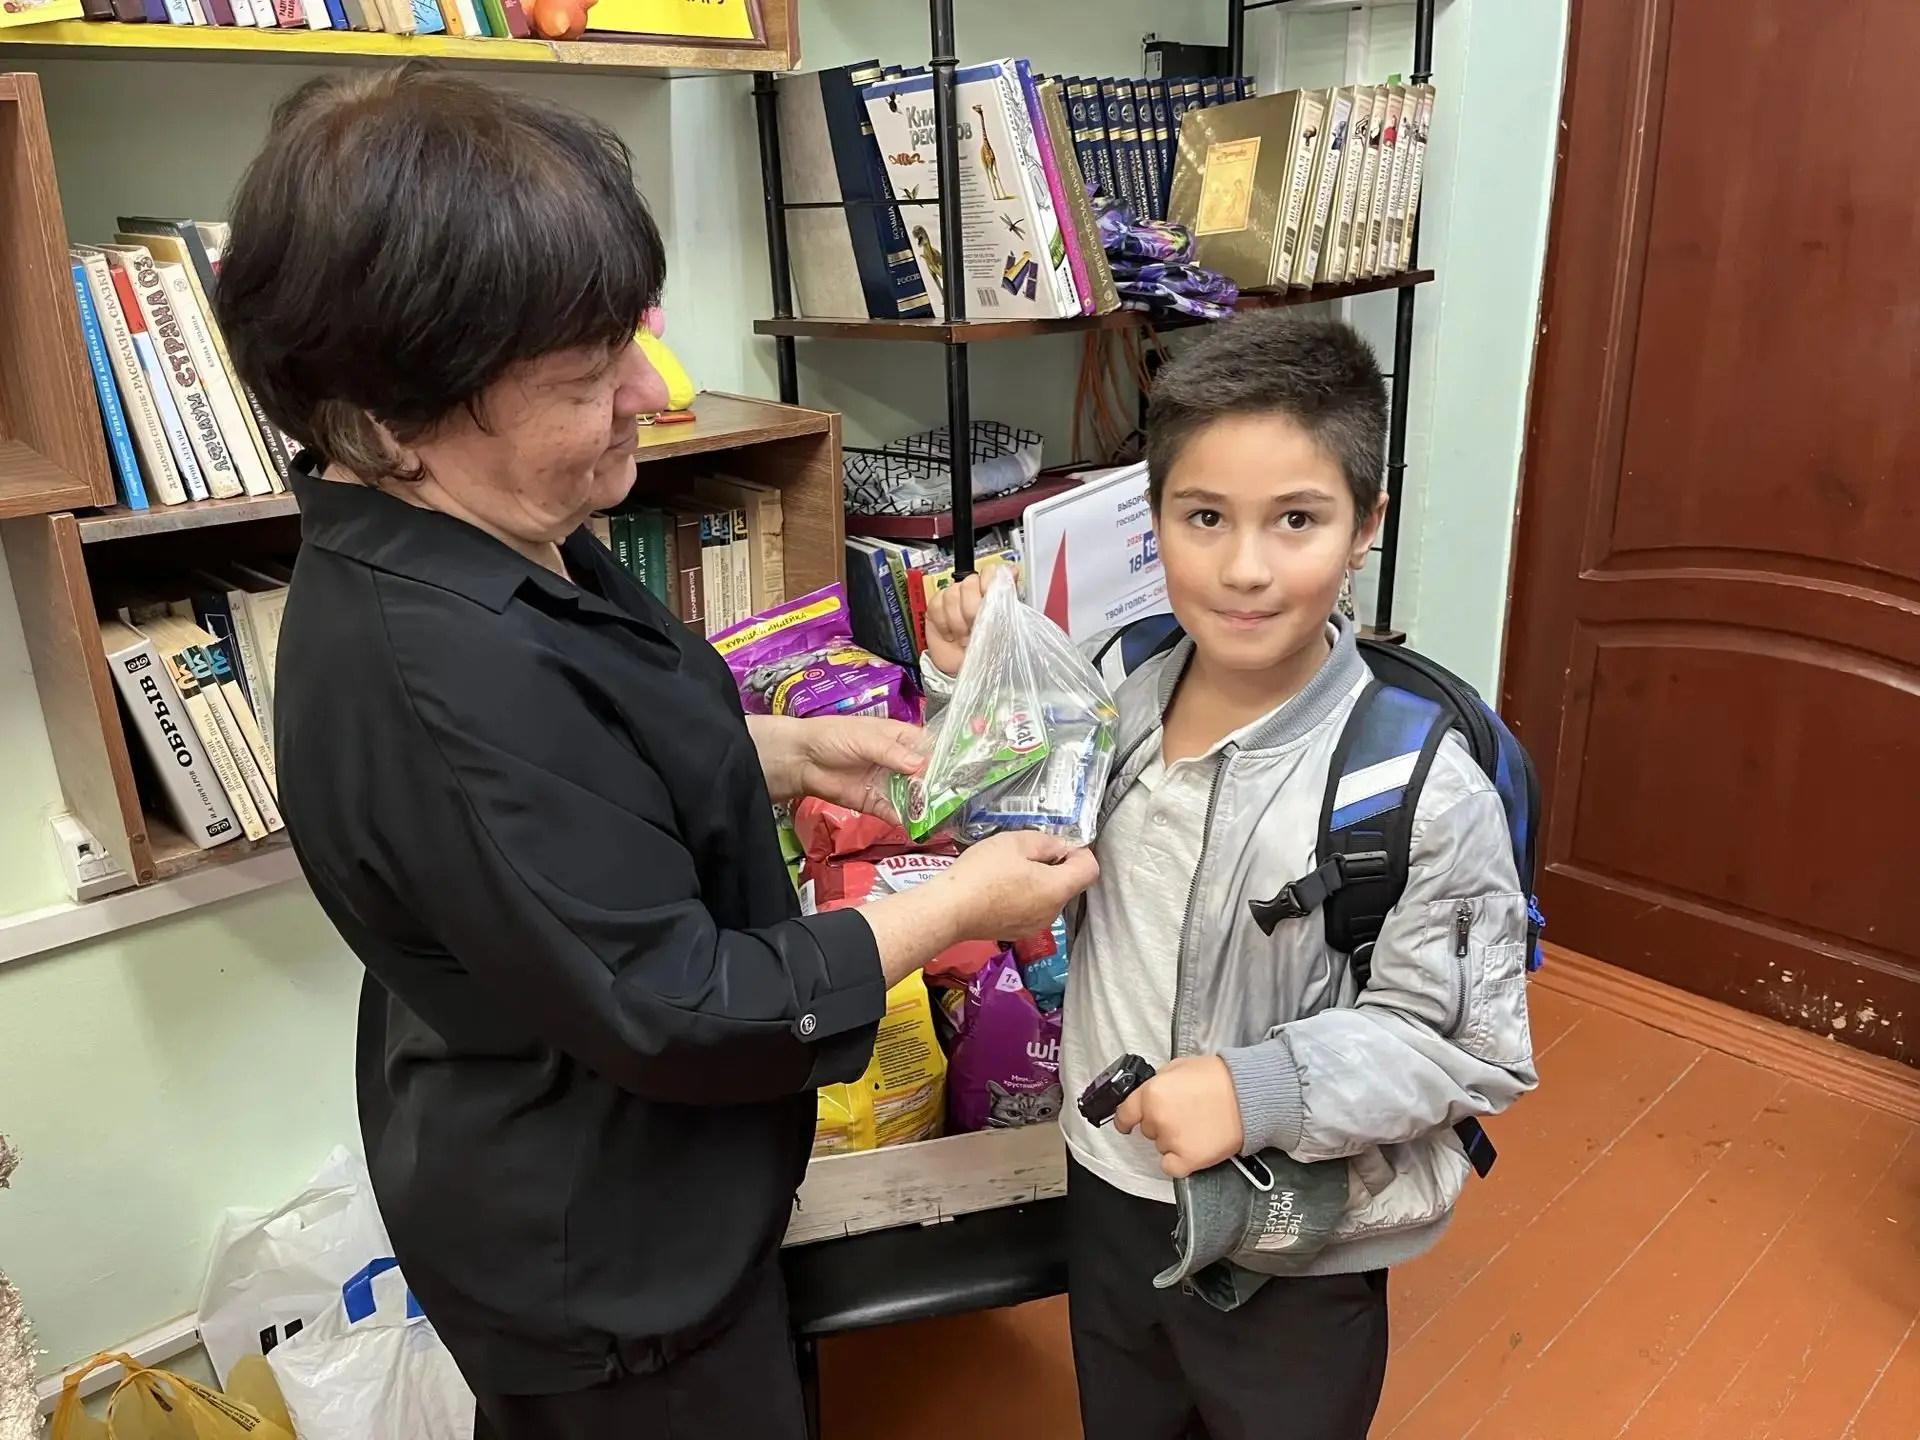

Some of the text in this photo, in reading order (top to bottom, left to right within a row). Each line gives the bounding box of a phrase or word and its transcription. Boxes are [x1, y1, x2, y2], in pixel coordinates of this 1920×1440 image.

[906, 106, 935, 128] Кни
[888, 206, 900, 239] БОЛЬША
[132, 254, 160, 290] ОЗ
[95, 268, 118, 318] СКАЗКИ
[147, 290, 197, 387] СТРАНА
[116, 326, 143, 389] РАССКАЗЫ
[262, 423, 279, 453] Уайльд
[119, 441, 134, 471] Некрасов
[274, 453, 289, 477] Оскар
[187, 462, 202, 488] ГЕРОИ
[1116, 508, 1149, 528] ГОСУДАРСТ
[1129, 537, 1157, 574] 18 19
[1105, 604, 1124, 621] ТВОЙ
[1125, 594, 1147, 612] ГОЛОС
[140, 676, 192, 768] ОБРЫВ
[208, 740, 235, 791] ДРАМАТИЧЕСКИЕ
[189, 770, 210, 805] ГОНЧАРОВ
[886, 856, 953, 870] Watso
[1263, 1202, 1281, 1233] FACE
[1274, 1191, 1295, 1234] NORTH
[1286, 1213, 1304, 1235] THE
